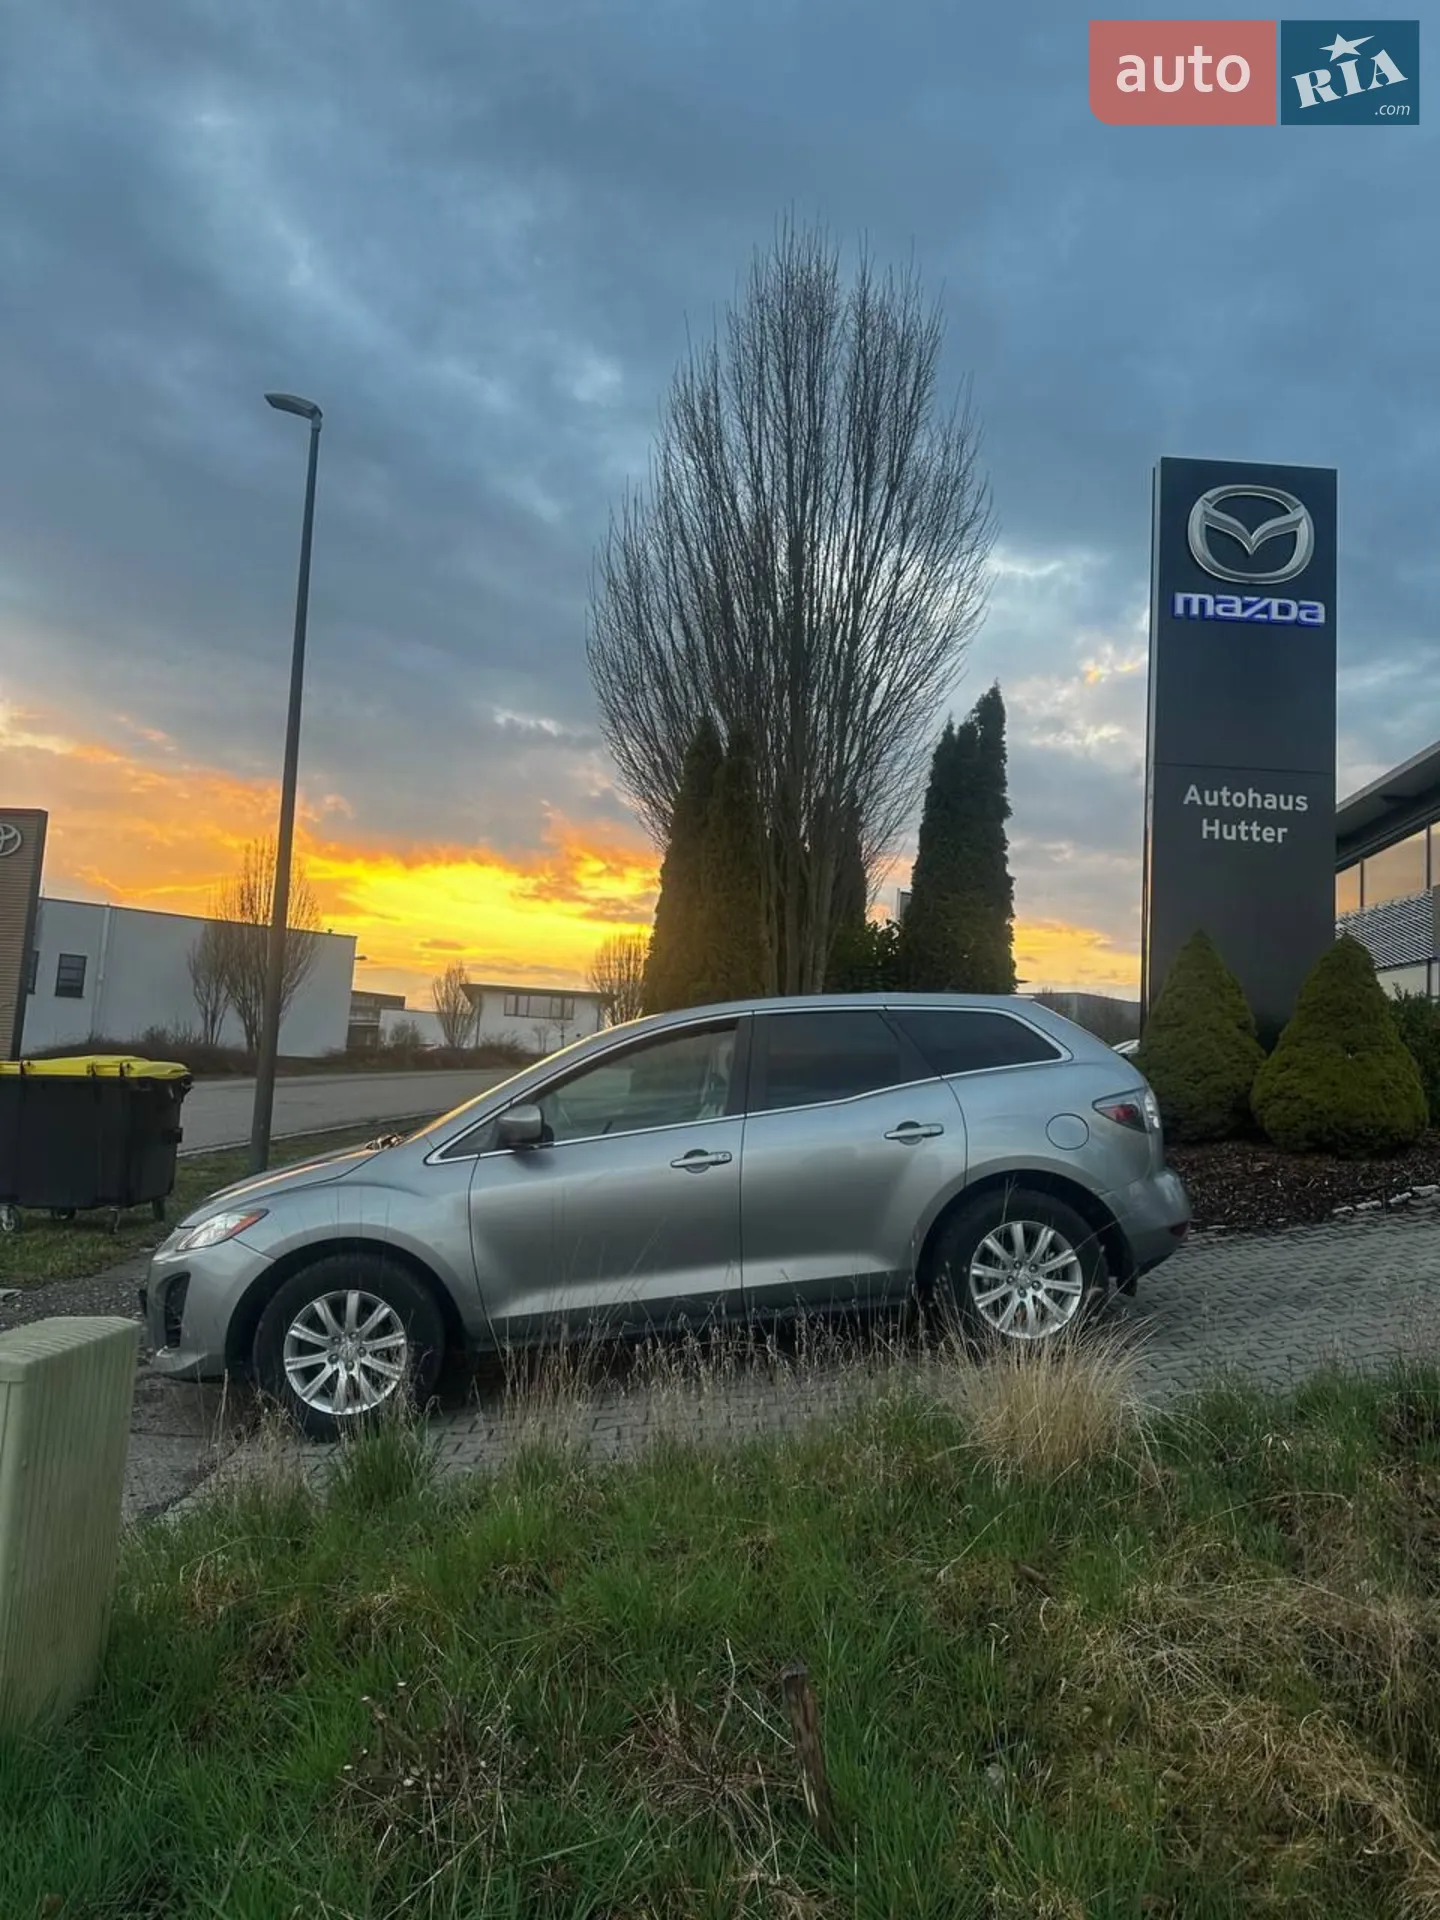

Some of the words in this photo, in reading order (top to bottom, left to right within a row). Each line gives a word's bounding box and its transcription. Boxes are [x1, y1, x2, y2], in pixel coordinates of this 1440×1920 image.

[1173, 592, 1326, 626] mazda
[1183, 784, 1308, 811] Autohaus
[1202, 818, 1288, 843] Hutter
